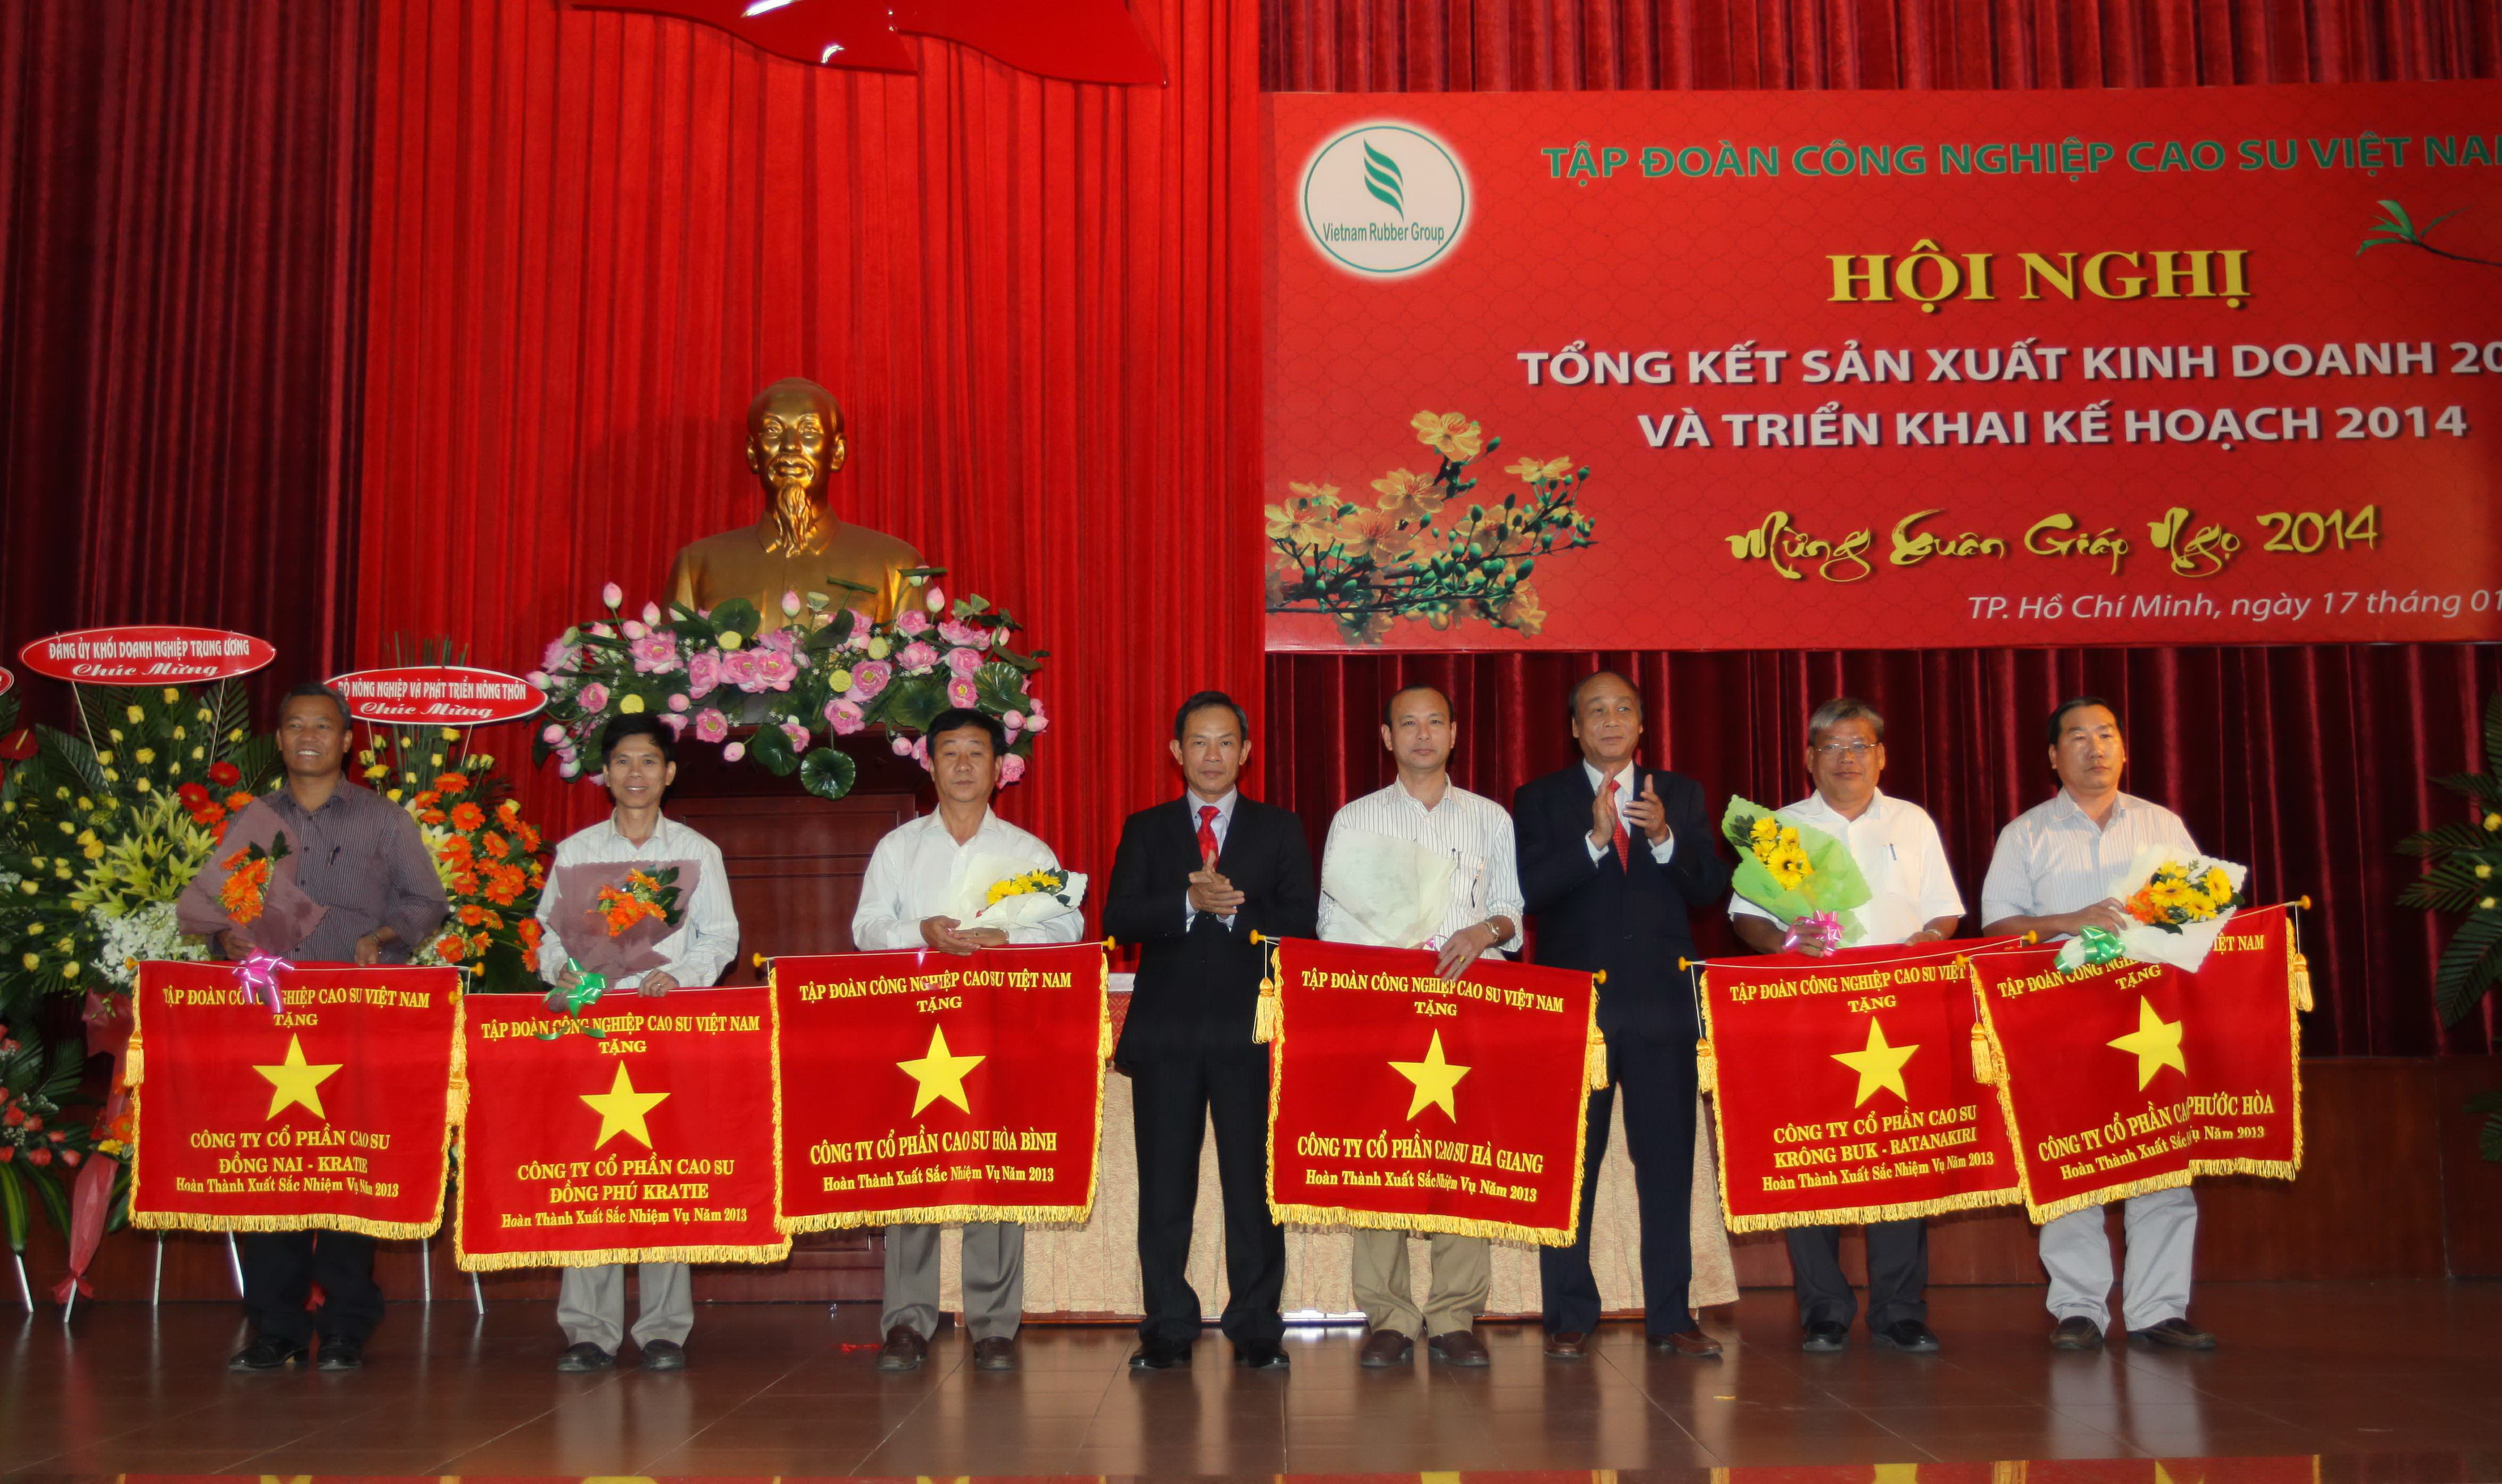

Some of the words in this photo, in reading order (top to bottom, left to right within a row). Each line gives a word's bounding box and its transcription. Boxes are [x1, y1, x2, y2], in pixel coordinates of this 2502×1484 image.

[1542, 141, 1628, 185] TẬP
[1640, 140, 1778, 177] ĐOÀN
[1794, 139, 1925, 176] CÔNG
[1941, 136, 2114, 181] NGHIỆP
[2128, 140, 2225, 171] CAO
[2239, 139, 2297, 170] SU
[2308, 131, 2412, 176] VIỆT
[2424, 136, 2502, 166] NA
[1323, 223, 1366, 241] Vietnam
[1370, 222, 1409, 241] Rubber
[1411, 222, 1444, 245] Group
[1826, 239, 1994, 313] HỘI
[2017, 250, 2249, 307] NGHỊ
[1517, 340, 1670, 384] TỔNG
[1689, 340, 1786, 383] KẾT
[1802, 340, 1909, 382] SẢN
[1926, 338, 2066, 381] XUẤT
[2083, 346, 2214, 379] KINH
[2232, 343, 2432, 377] DOANH
[1638, 407, 1710, 446] VÀ
[1722, 402, 1878, 446] TRIỂN
[1896, 412, 2025, 444] KHAI
[2044, 400, 2109, 443] KẾ
[2125, 407, 2317, 450] HOẠCH
[2336, 406, 2466, 438] 2014
[2258, 504, 2377, 553] 2014
[1969, 597, 2008, 619] TP.
[2019, 594, 2063, 619] Hồ
[2072, 595, 2126, 618] Chí
[2131, 593, 2221, 619] Minh,
[2231, 593, 2311, 621] ngày
[2324, 592, 2358, 613] 17
[2367, 590, 2461, 618] tháng
[49, 637, 76, 660] ĐẢNG
[78, 637, 90, 660] ỦY
[93, 636, 116, 660] KHỐI
[119, 641, 152, 658] DOANH
[154, 637, 188, 661] NGHIỆP
[190, 640, 222, 658] TRUNG
[224, 638, 249, 656] ƯƠNG
[72, 664, 136, 676] Chúc
[142, 663, 218, 677] Mừng
[352, 678, 375, 697] NÔNG
[377, 678, 408, 701] NGHIỆP
[410, 679, 422, 698] VÀ
[423, 679, 447, 699] PHÁT
[448, 676, 474, 699] TRIỂN
[476, 680, 501, 699] NÔNG
[502, 680, 526, 701] THÔN
[360, 702, 416, 714] Chúc
[421, 703, 493, 719] Mừng
[799, 981, 826, 1003] TẬP
[829, 978, 866, 998] ĐOÀN
[870, 976, 907, 995] CÔNG
[963, 971, 989, 986] CAO
[990, 971, 1005, 987] SU
[1007, 968, 1039, 991] VIỆT
[1042, 972, 1071, 987] NAM
[1302, 968, 1328, 990] TẬP
[1331, 970, 1368, 989] ĐOÀN
[1371, 972, 1408, 991] CÔNG
[1457, 980, 1483, 999] CAO
[1486, 986, 1500, 1003] SU
[1504, 988, 1534, 1010] VIỆT
[1536, 995, 1563, 1013] NAM
[916, 996, 962, 1013] TẶNG
[1414, 999, 1457, 1016] TẶNG
[1848, 995, 1896, 1013] TẶNG
[598, 1038, 647, 1055] TẶNG
[190, 1129, 236, 1148] CÔNG
[240, 1133, 262, 1147] TY
[267, 1124, 290, 1147] CỔ
[296, 1123, 346, 1146] PHẦN
[350, 1131, 369, 1147] CAO
[370, 1134, 390, 1149] SU
[1774, 1123, 1822, 1143] CÔNG
[1826, 1121, 1848, 1137] TY
[1854, 1111, 1878, 1135] CỔ
[1882, 1106, 1924, 1132] PHẦN
[1929, 1108, 1957, 1125] CAO
[1959, 1105, 1976, 1121] SU
[2039, 1135, 2081, 1161] CÔNG
[2081, 1129, 2102, 1150] TY
[2104, 1112, 2126, 1144] CỔ
[2126, 1101, 2172, 1136] PHẦN
[2242, 1089, 2274, 1115] HÒA
[811, 1139, 852, 1164] CÔNG
[855, 1141, 873, 1161] TY
[877, 1129, 895, 1158] CỔ
[899, 1124, 938, 1156] PHẦN
[943, 1131, 970, 1152] CAO
[971, 1131, 990, 1149] SU
[993, 1126, 1018, 1151] HÒA
[1021, 1127, 1057, 1150] BÌNH
[1298, 1132, 1340, 1156] CÔNG
[1343, 1139, 1363, 1157] TY
[1366, 1129, 1388, 1158] CỔ
[1391, 1129, 1432, 1158] PHẦN
[1435, 1140, 1454, 1161] CAO
[1454, 1143, 1470, 1163] SU
[1470, 1141, 1491, 1166] HÀ
[1497, 1149, 1543, 1173] GIANG
[1774, 1146, 1837, 1168] KRÔNG
[1840, 1143, 1879, 1161] BUK
[219, 1151, 268, 1173] ĐỒNG
[272, 1157, 303, 1172] NAI
[318, 1156, 367, 1173] KRATIE
[518, 1161, 566, 1180] CÔNG
[570, 1162, 590, 1177] TY
[595, 1153, 618, 1176] CỔ
[622, 1152, 672, 1175] PHẦN
[677, 1159, 711, 1174] CAO
[714, 1160, 735, 1175] SU
[1762, 1175, 1796, 1191] Hoàn
[1798, 1171, 1838, 1188] Thành
[1840, 1166, 1870, 1183] Xuất
[1872, 1162, 1892, 1180] Sắc
[1894, 1161, 1930, 1177] Nhiệm
[1931, 1158, 1945, 1174] Vụ
[1947, 1155, 1966, 1169] Năm
[1969, 1152, 1994, 1166] 2013
[823, 1177, 855, 1191] Hoàn
[858, 1172, 894, 1188] Thành
[896, 1167, 923, 1185] Xuất
[925, 1164, 947, 1182] Sắc
[950, 1165, 982, 1181] Nhiệm
[986, 1165, 1000, 1183] Vụ
[1002, 1166, 1026, 1180] Năm
[1029, 1167, 1054, 1181] 2013
[550, 1180, 598, 1203] ĐỒNG
[602, 1180, 638, 1200] PHÚ
[643, 1183, 708, 1199] KRATIE
[501, 1214, 532, 1228] Hoàn
[535, 1211, 573, 1225] Thành
[576, 1207, 603, 1224] Xuất
[606, 1206, 626, 1223] Sắc
[629, 1208, 670, 1225] Nhiệm
[673, 1208, 690, 1224] Vụ
[694, 1208, 722, 1221] Năm
[724, 1208, 747, 1221] 2013
